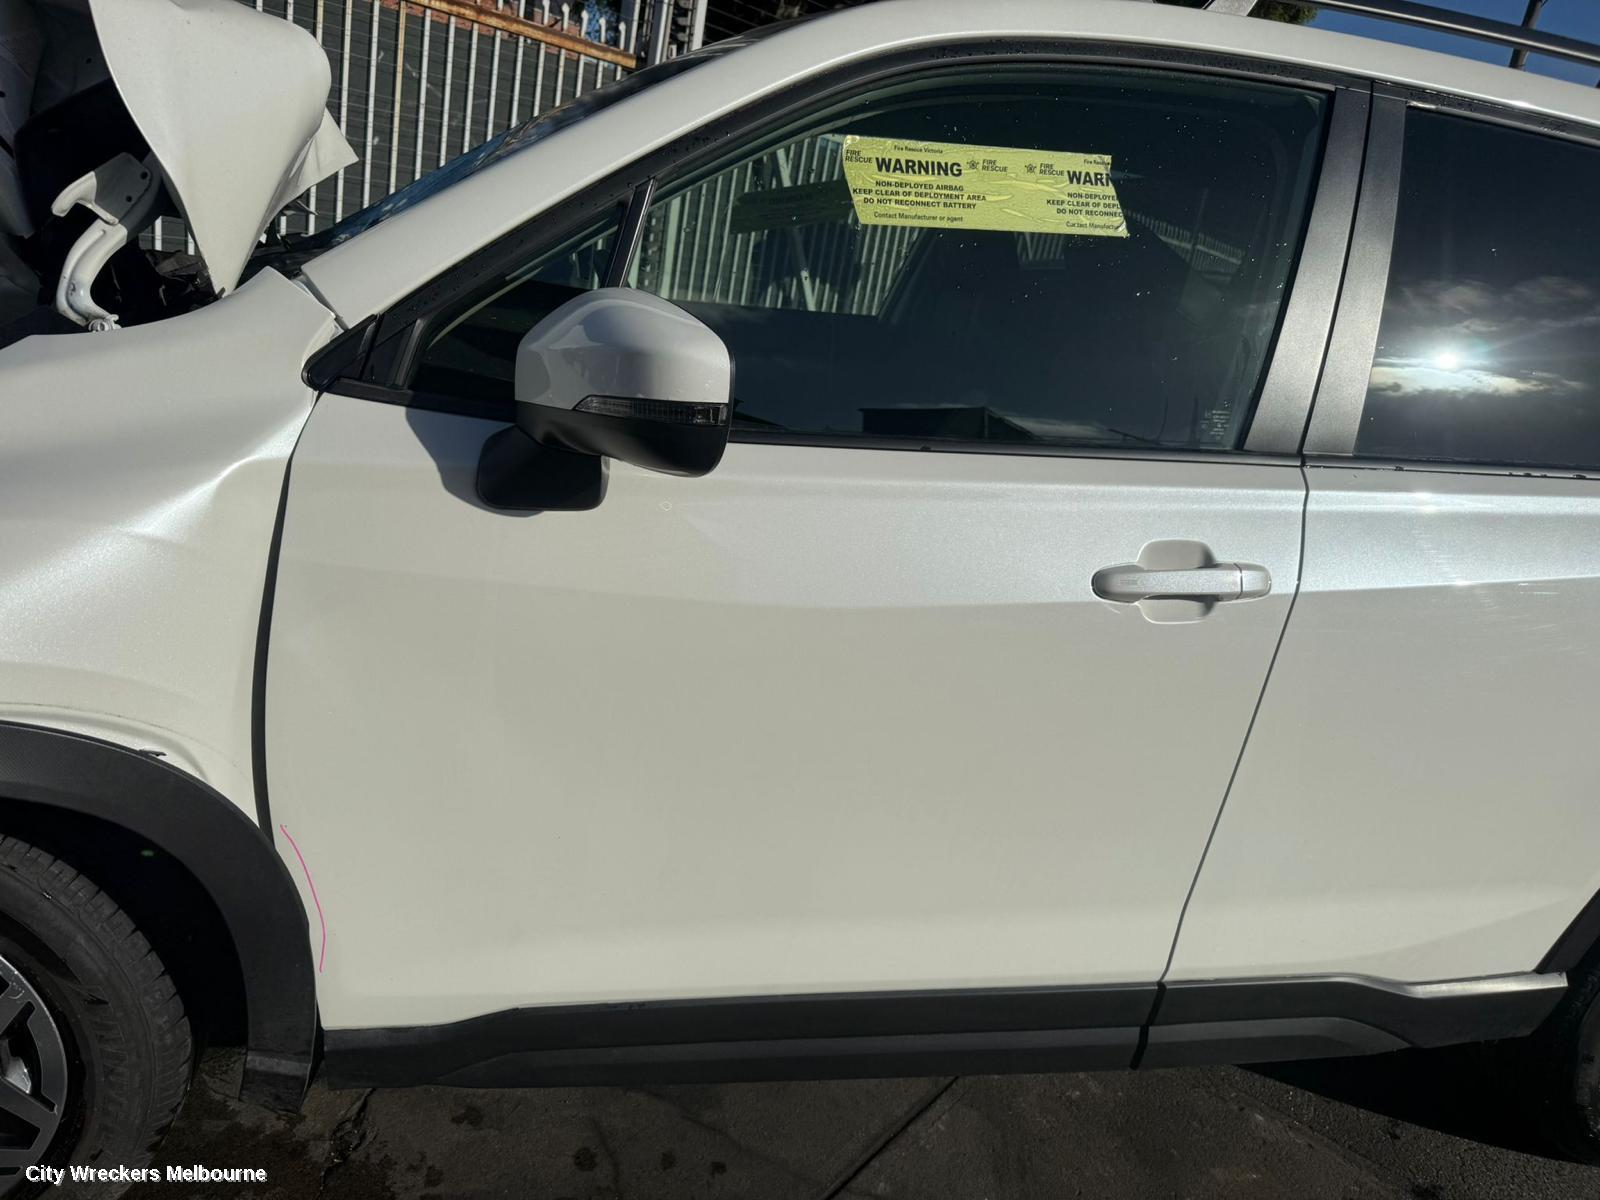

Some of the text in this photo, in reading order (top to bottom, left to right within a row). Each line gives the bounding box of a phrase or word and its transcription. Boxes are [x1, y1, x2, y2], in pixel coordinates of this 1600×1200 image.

[875, 157, 962, 177] WARNING
[876, 180, 934, 190] NON-DEPLOYED
[914, 192, 964, 200] DEPLOYMENT
[874, 211, 897, 219] Contact
[898, 213, 938, 221] Manufacturer
